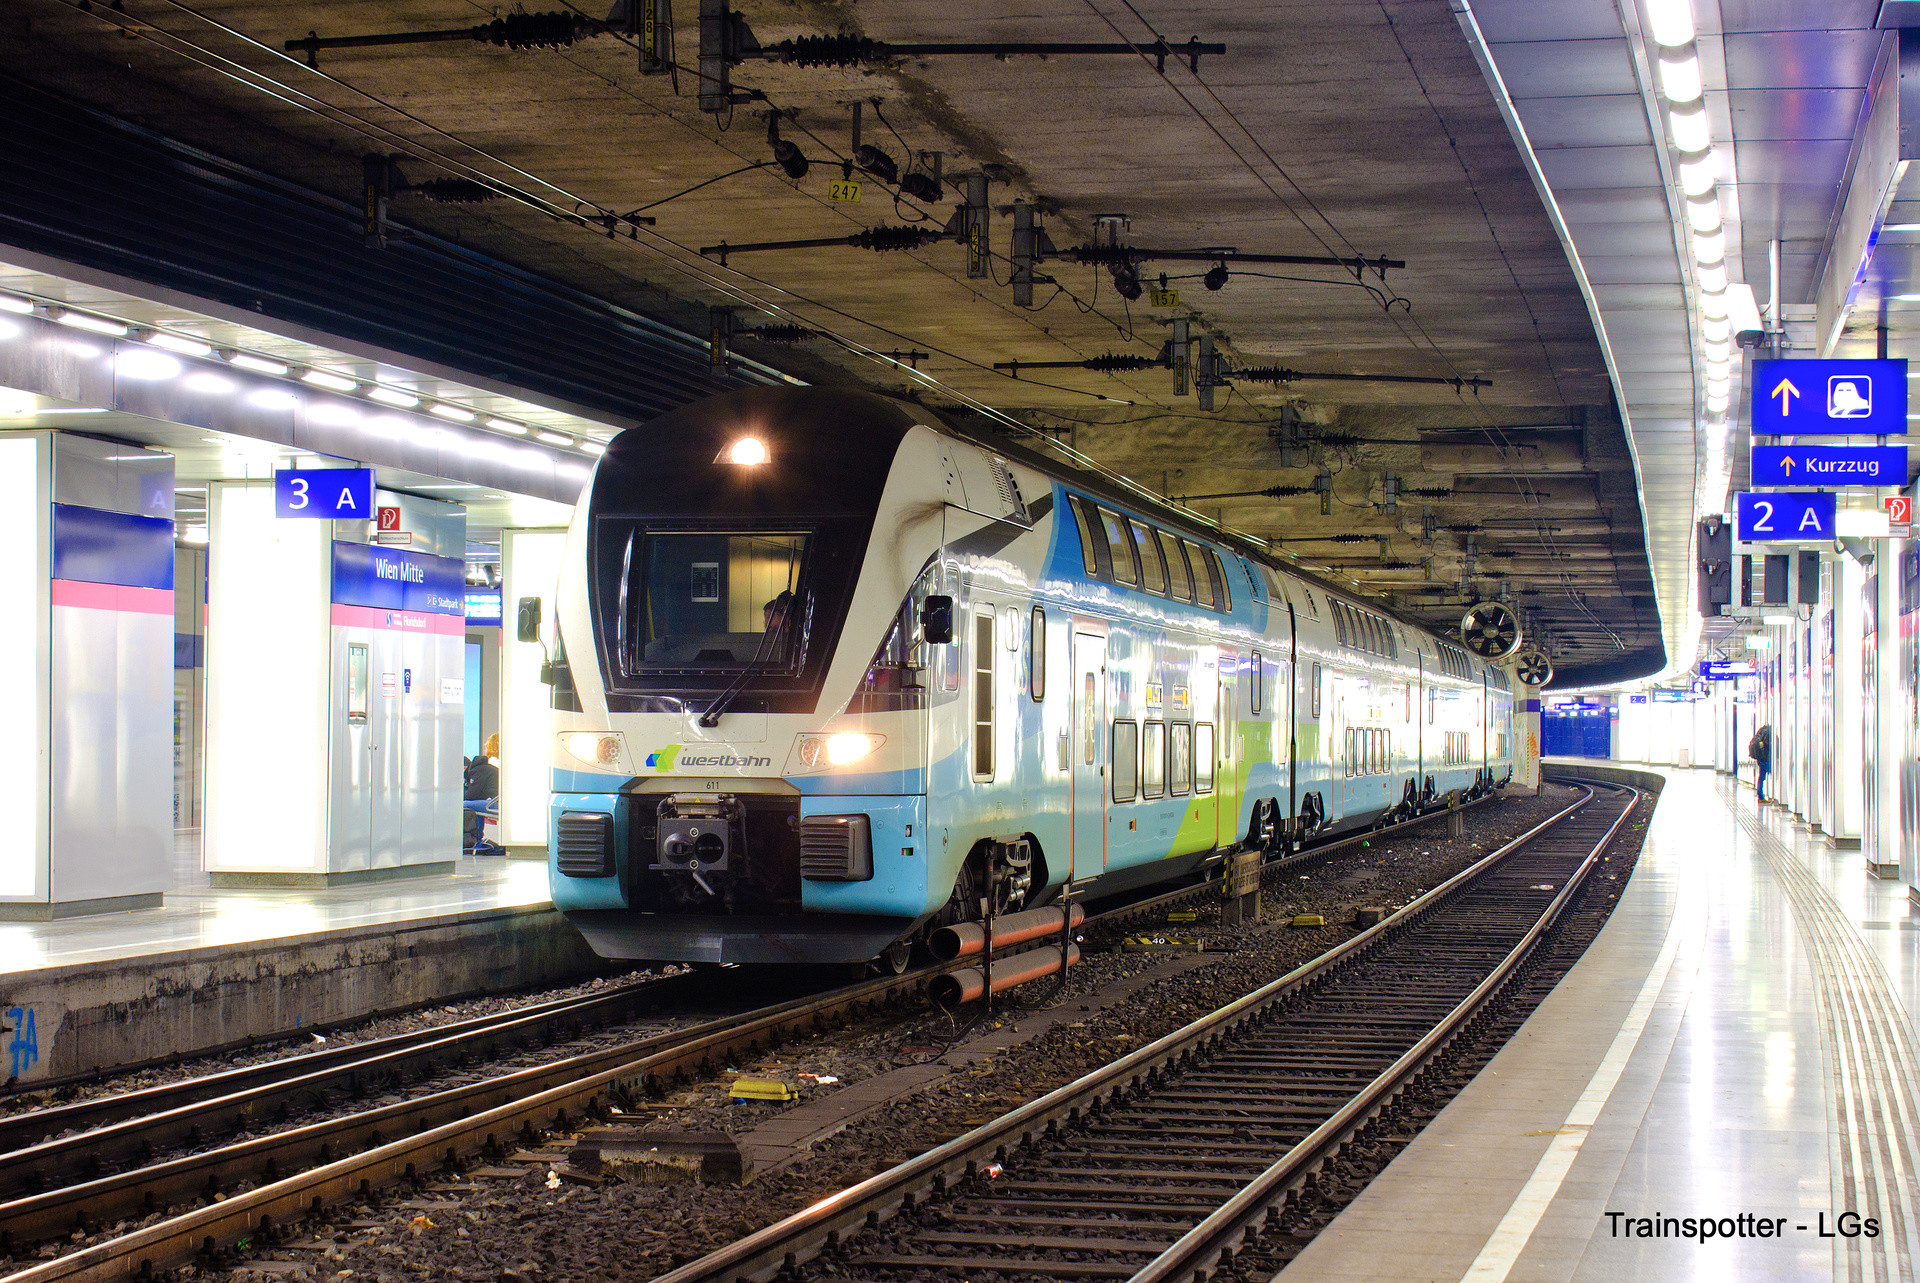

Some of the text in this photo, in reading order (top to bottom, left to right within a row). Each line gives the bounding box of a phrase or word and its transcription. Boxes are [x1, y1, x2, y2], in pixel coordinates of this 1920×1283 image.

[832, 184, 858, 200] 247
[1155, 293, 1176, 305] 157
[1805, 457, 1879, 477] Kurzzug
[288, 478, 357, 510] 3 A
[1753, 501, 1822, 532] 2 A
[375, 557, 424, 584] Wien Mitte
[681, 755, 771, 767] westbahn
[706, 781, 720, 790] 611
